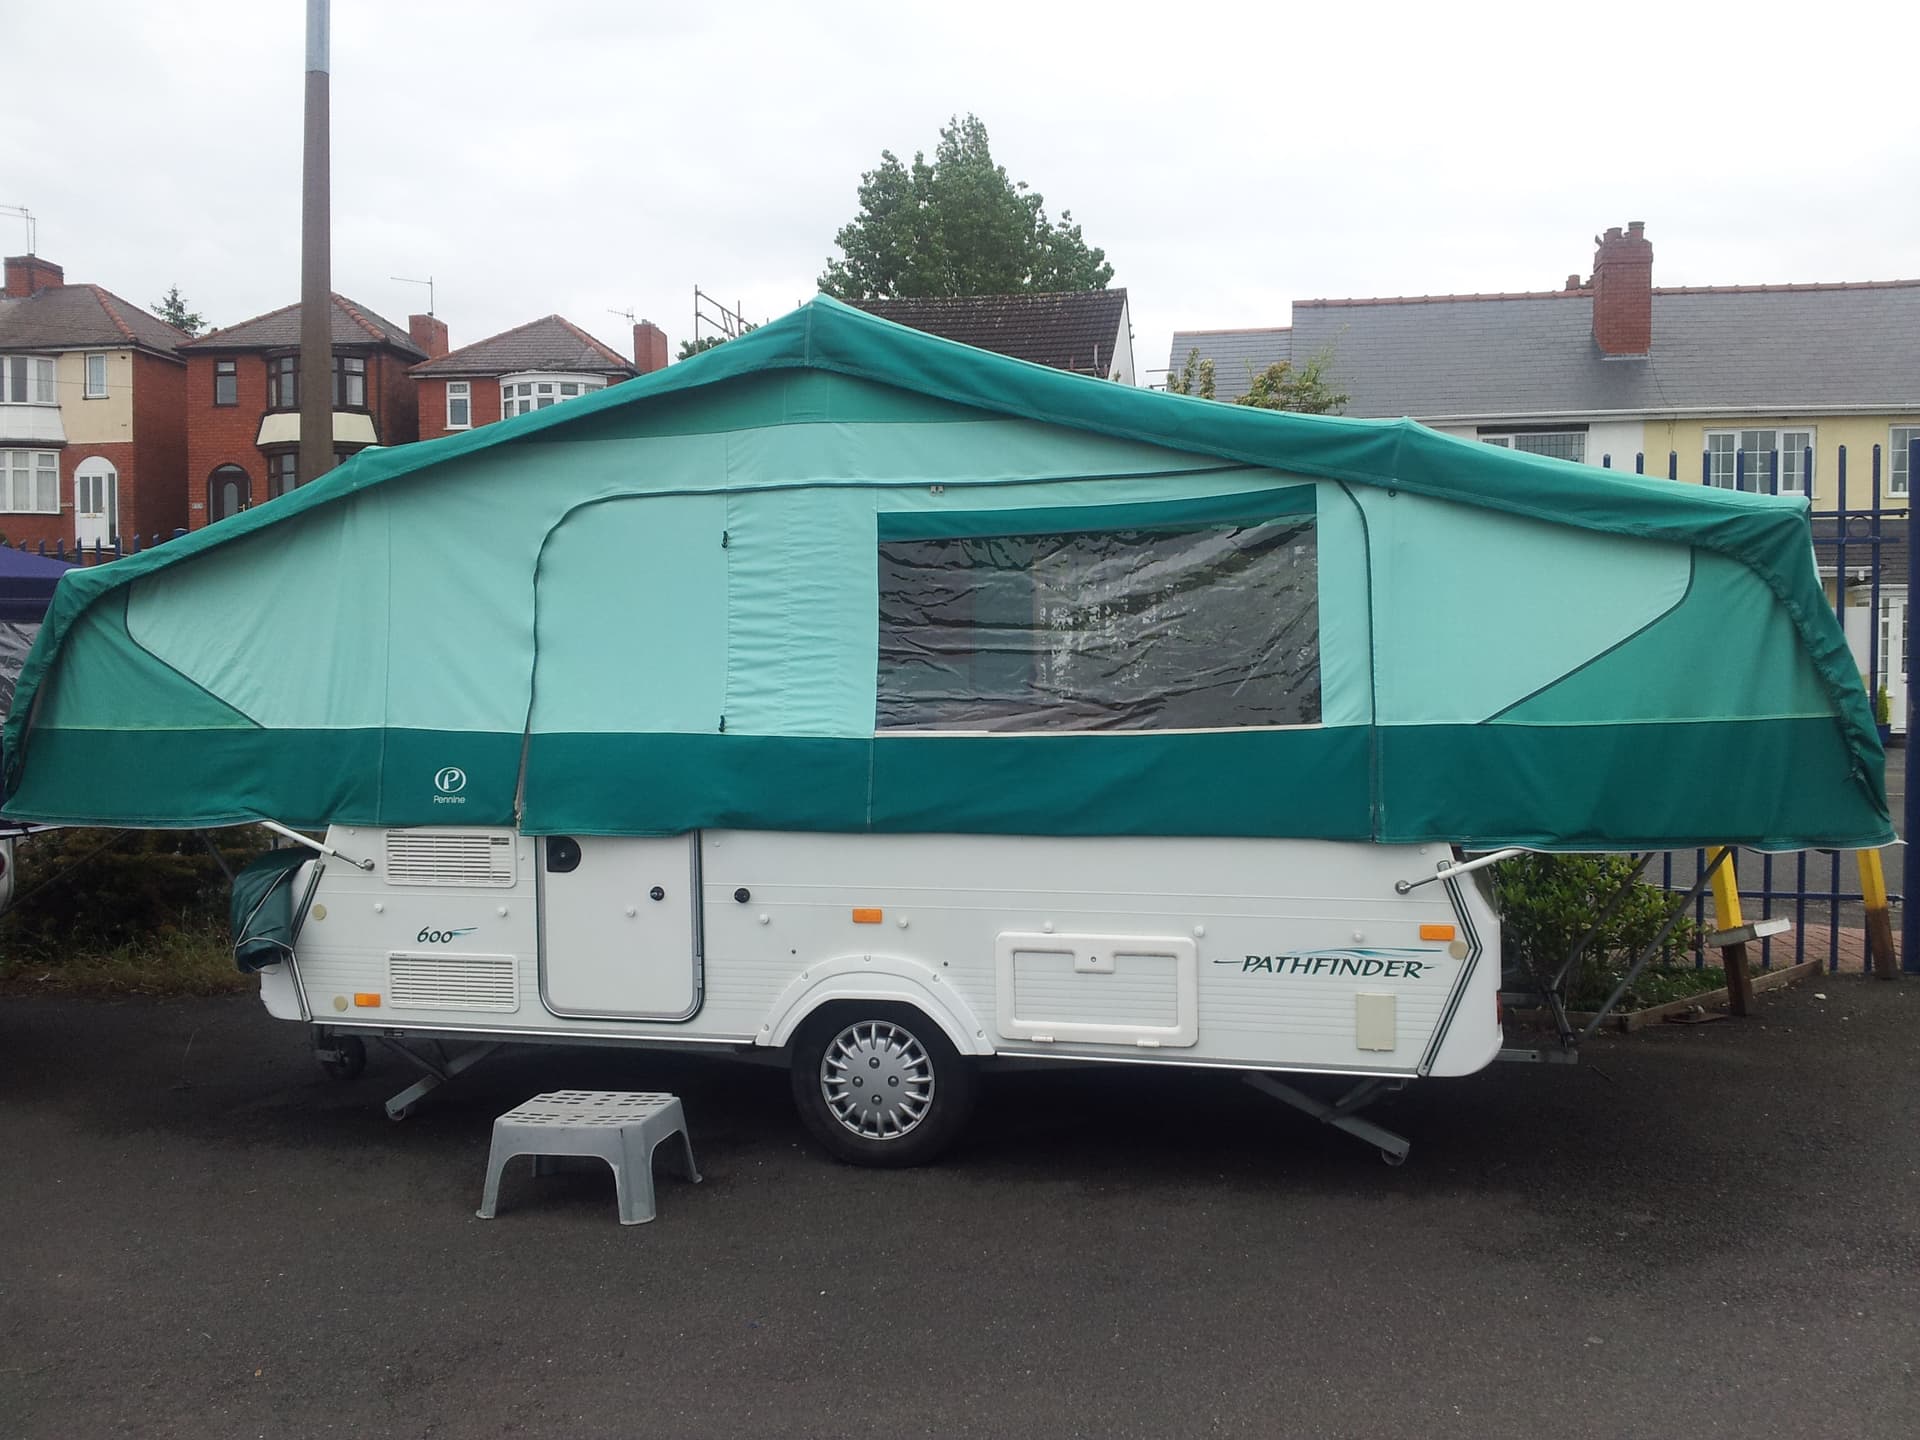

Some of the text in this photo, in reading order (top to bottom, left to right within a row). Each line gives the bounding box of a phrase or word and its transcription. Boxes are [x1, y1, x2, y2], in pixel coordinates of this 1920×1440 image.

[433, 795, 466, 804] Pennine
[417, 926, 453, 943] 600
[1241, 955, 1423, 979] PATHFINDER
